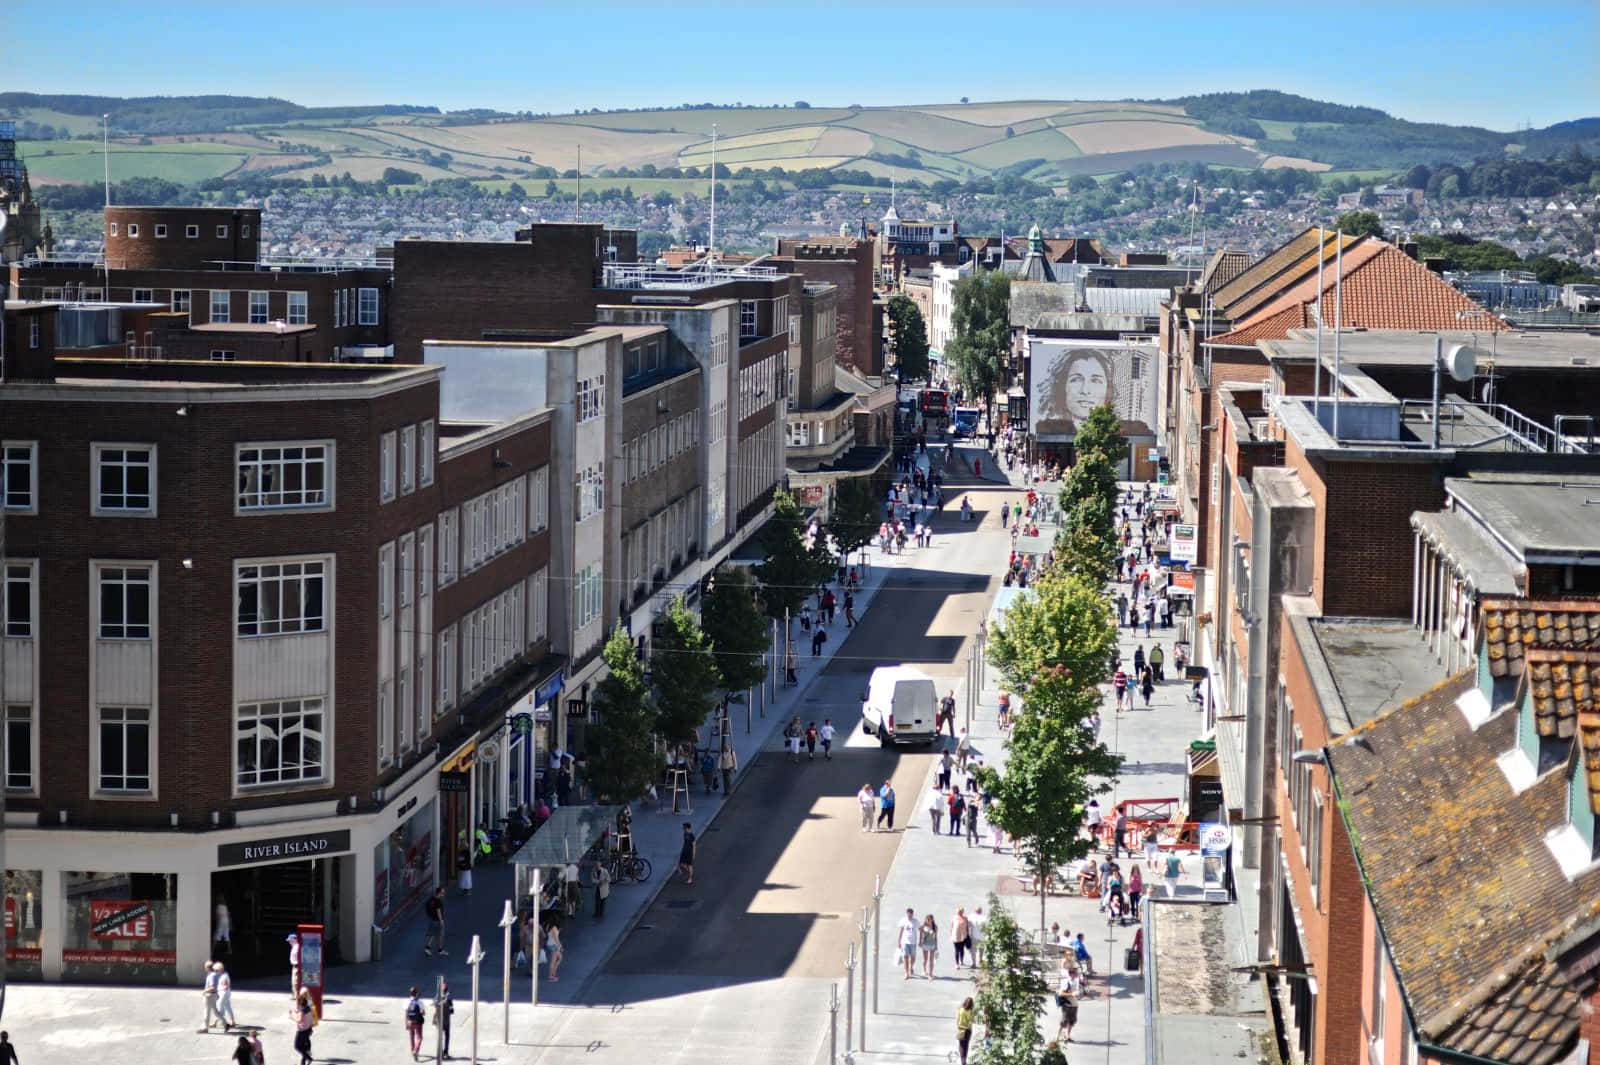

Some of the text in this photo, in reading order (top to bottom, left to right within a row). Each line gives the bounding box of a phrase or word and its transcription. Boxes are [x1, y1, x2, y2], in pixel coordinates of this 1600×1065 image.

[244, 839, 328, 859] RIVER ISLAND
[100, 920, 148, 937] ALE
